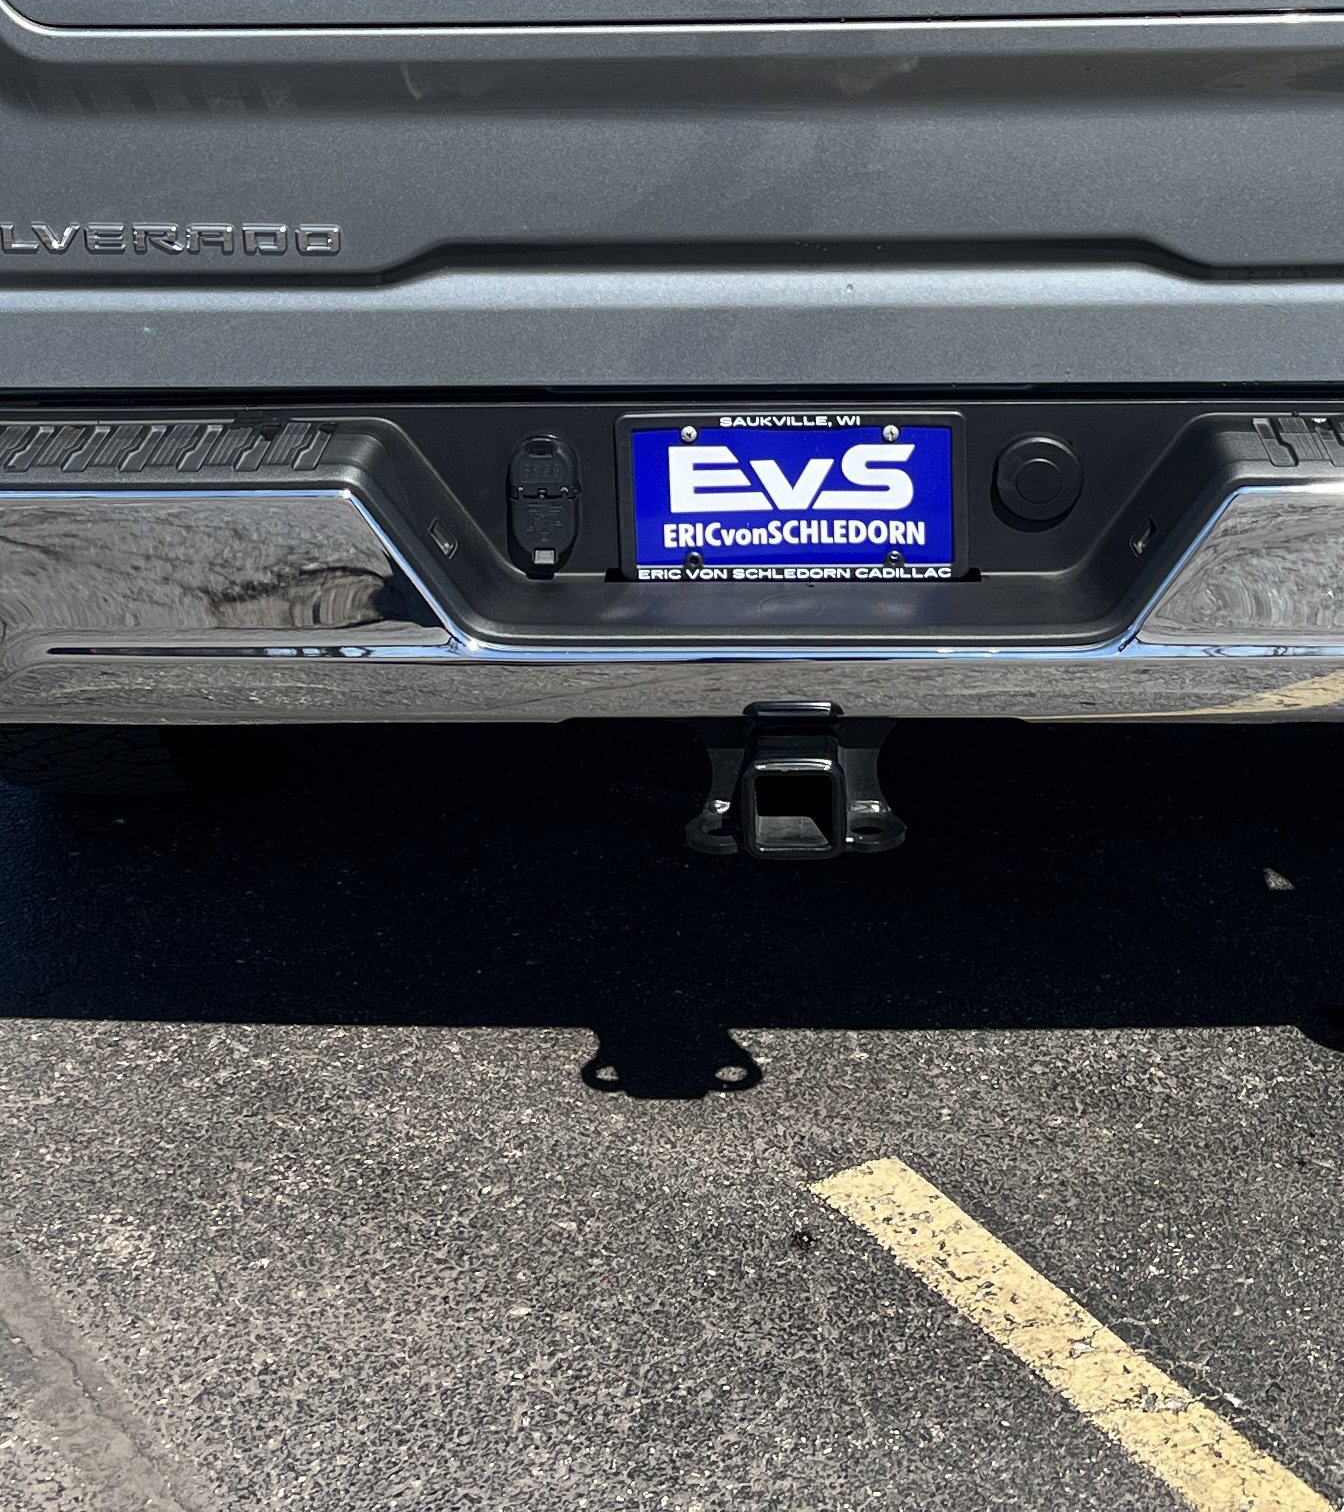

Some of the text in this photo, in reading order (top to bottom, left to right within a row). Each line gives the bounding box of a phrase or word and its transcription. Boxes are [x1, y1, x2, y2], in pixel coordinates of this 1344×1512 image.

[719, 415, 861, 427] SAUKVILLE, WI
[638, 567, 952, 580] ERIC VON SCHLEDORN CADILLAC
